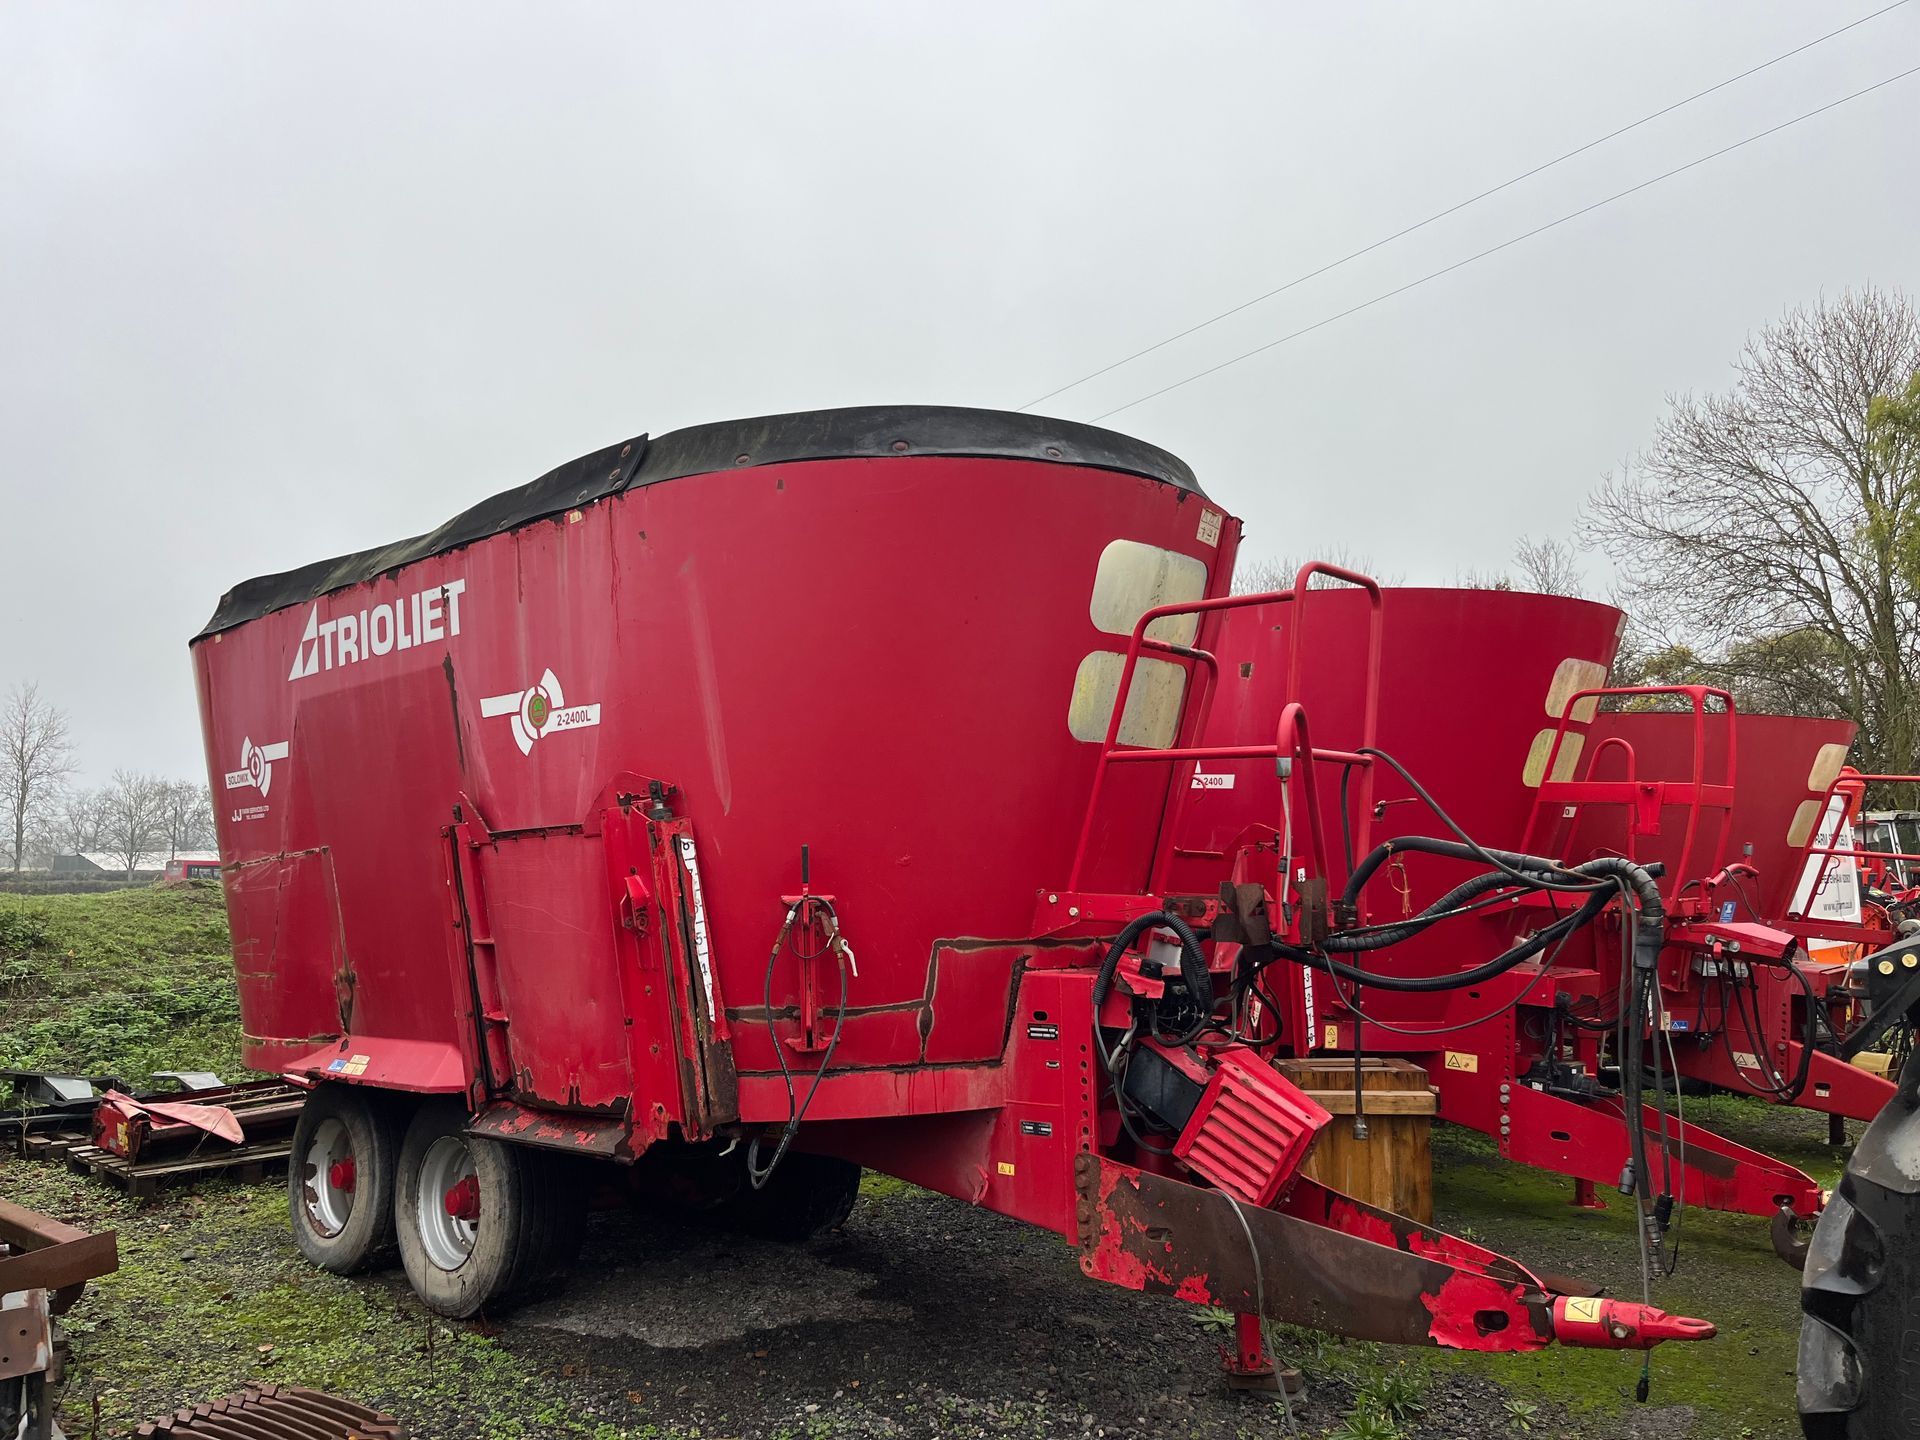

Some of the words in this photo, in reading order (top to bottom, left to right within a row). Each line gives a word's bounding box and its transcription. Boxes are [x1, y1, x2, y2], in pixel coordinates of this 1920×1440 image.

[318, 578, 466, 671] TRIOLIET
[556, 709, 592, 727] 2-2400L
[227, 772, 250, 786] SOLOMIX
